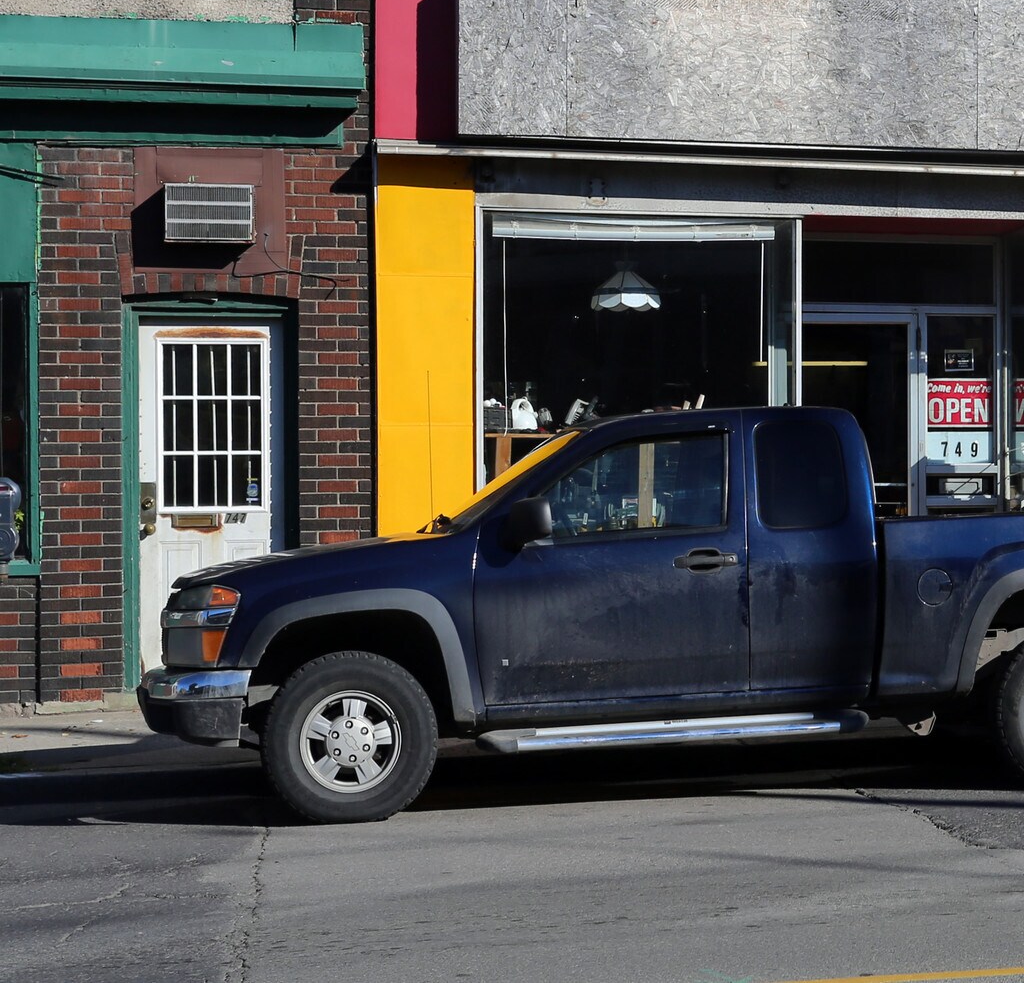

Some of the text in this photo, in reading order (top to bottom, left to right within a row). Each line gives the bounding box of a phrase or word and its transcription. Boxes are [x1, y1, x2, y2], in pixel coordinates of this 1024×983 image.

[928, 383, 992, 395] Come in, we're
[928, 398, 989, 423] OPEN
[941, 441, 979, 458] 749
[225, 513, 248, 524] 747
